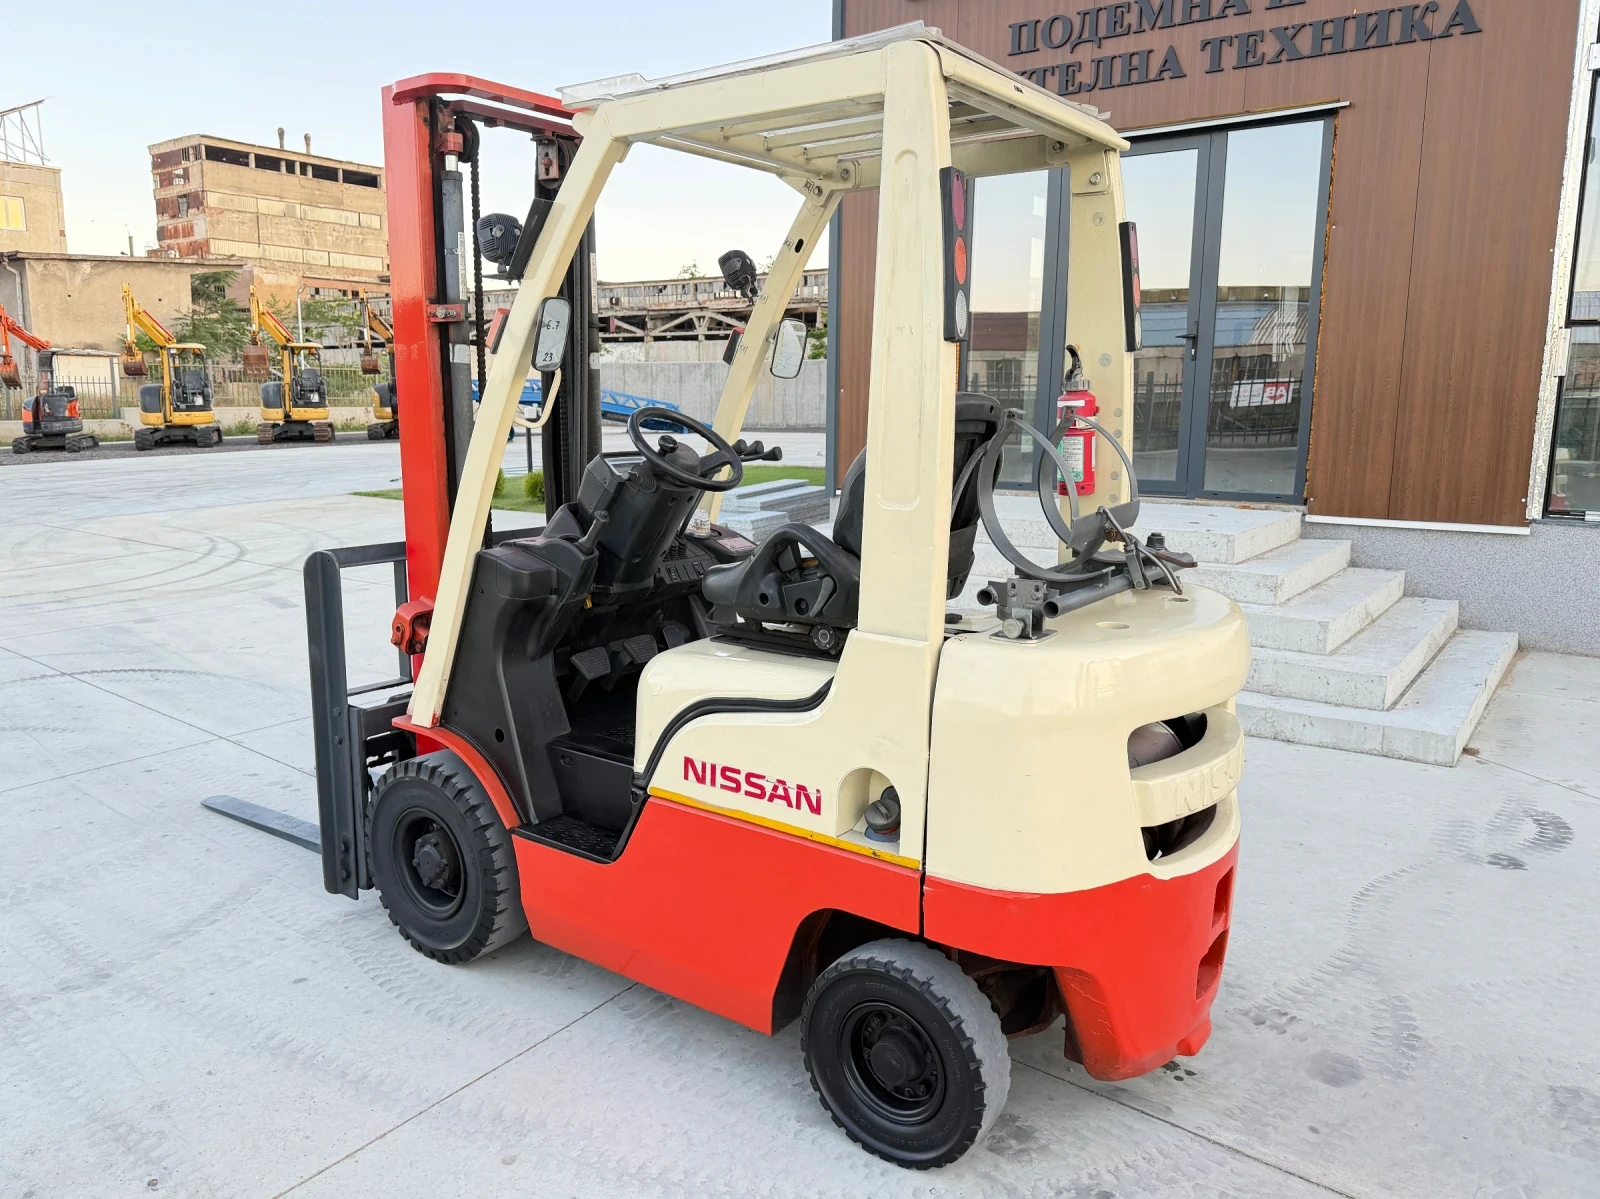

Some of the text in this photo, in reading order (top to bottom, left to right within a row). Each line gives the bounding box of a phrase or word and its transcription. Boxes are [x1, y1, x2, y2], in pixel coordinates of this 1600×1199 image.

[1017, 0, 1483, 97] ТЕЛНА ТЕХНИКА
[542, 352, 554, 362] 23
[683, 755, 822, 816] NISSAN
